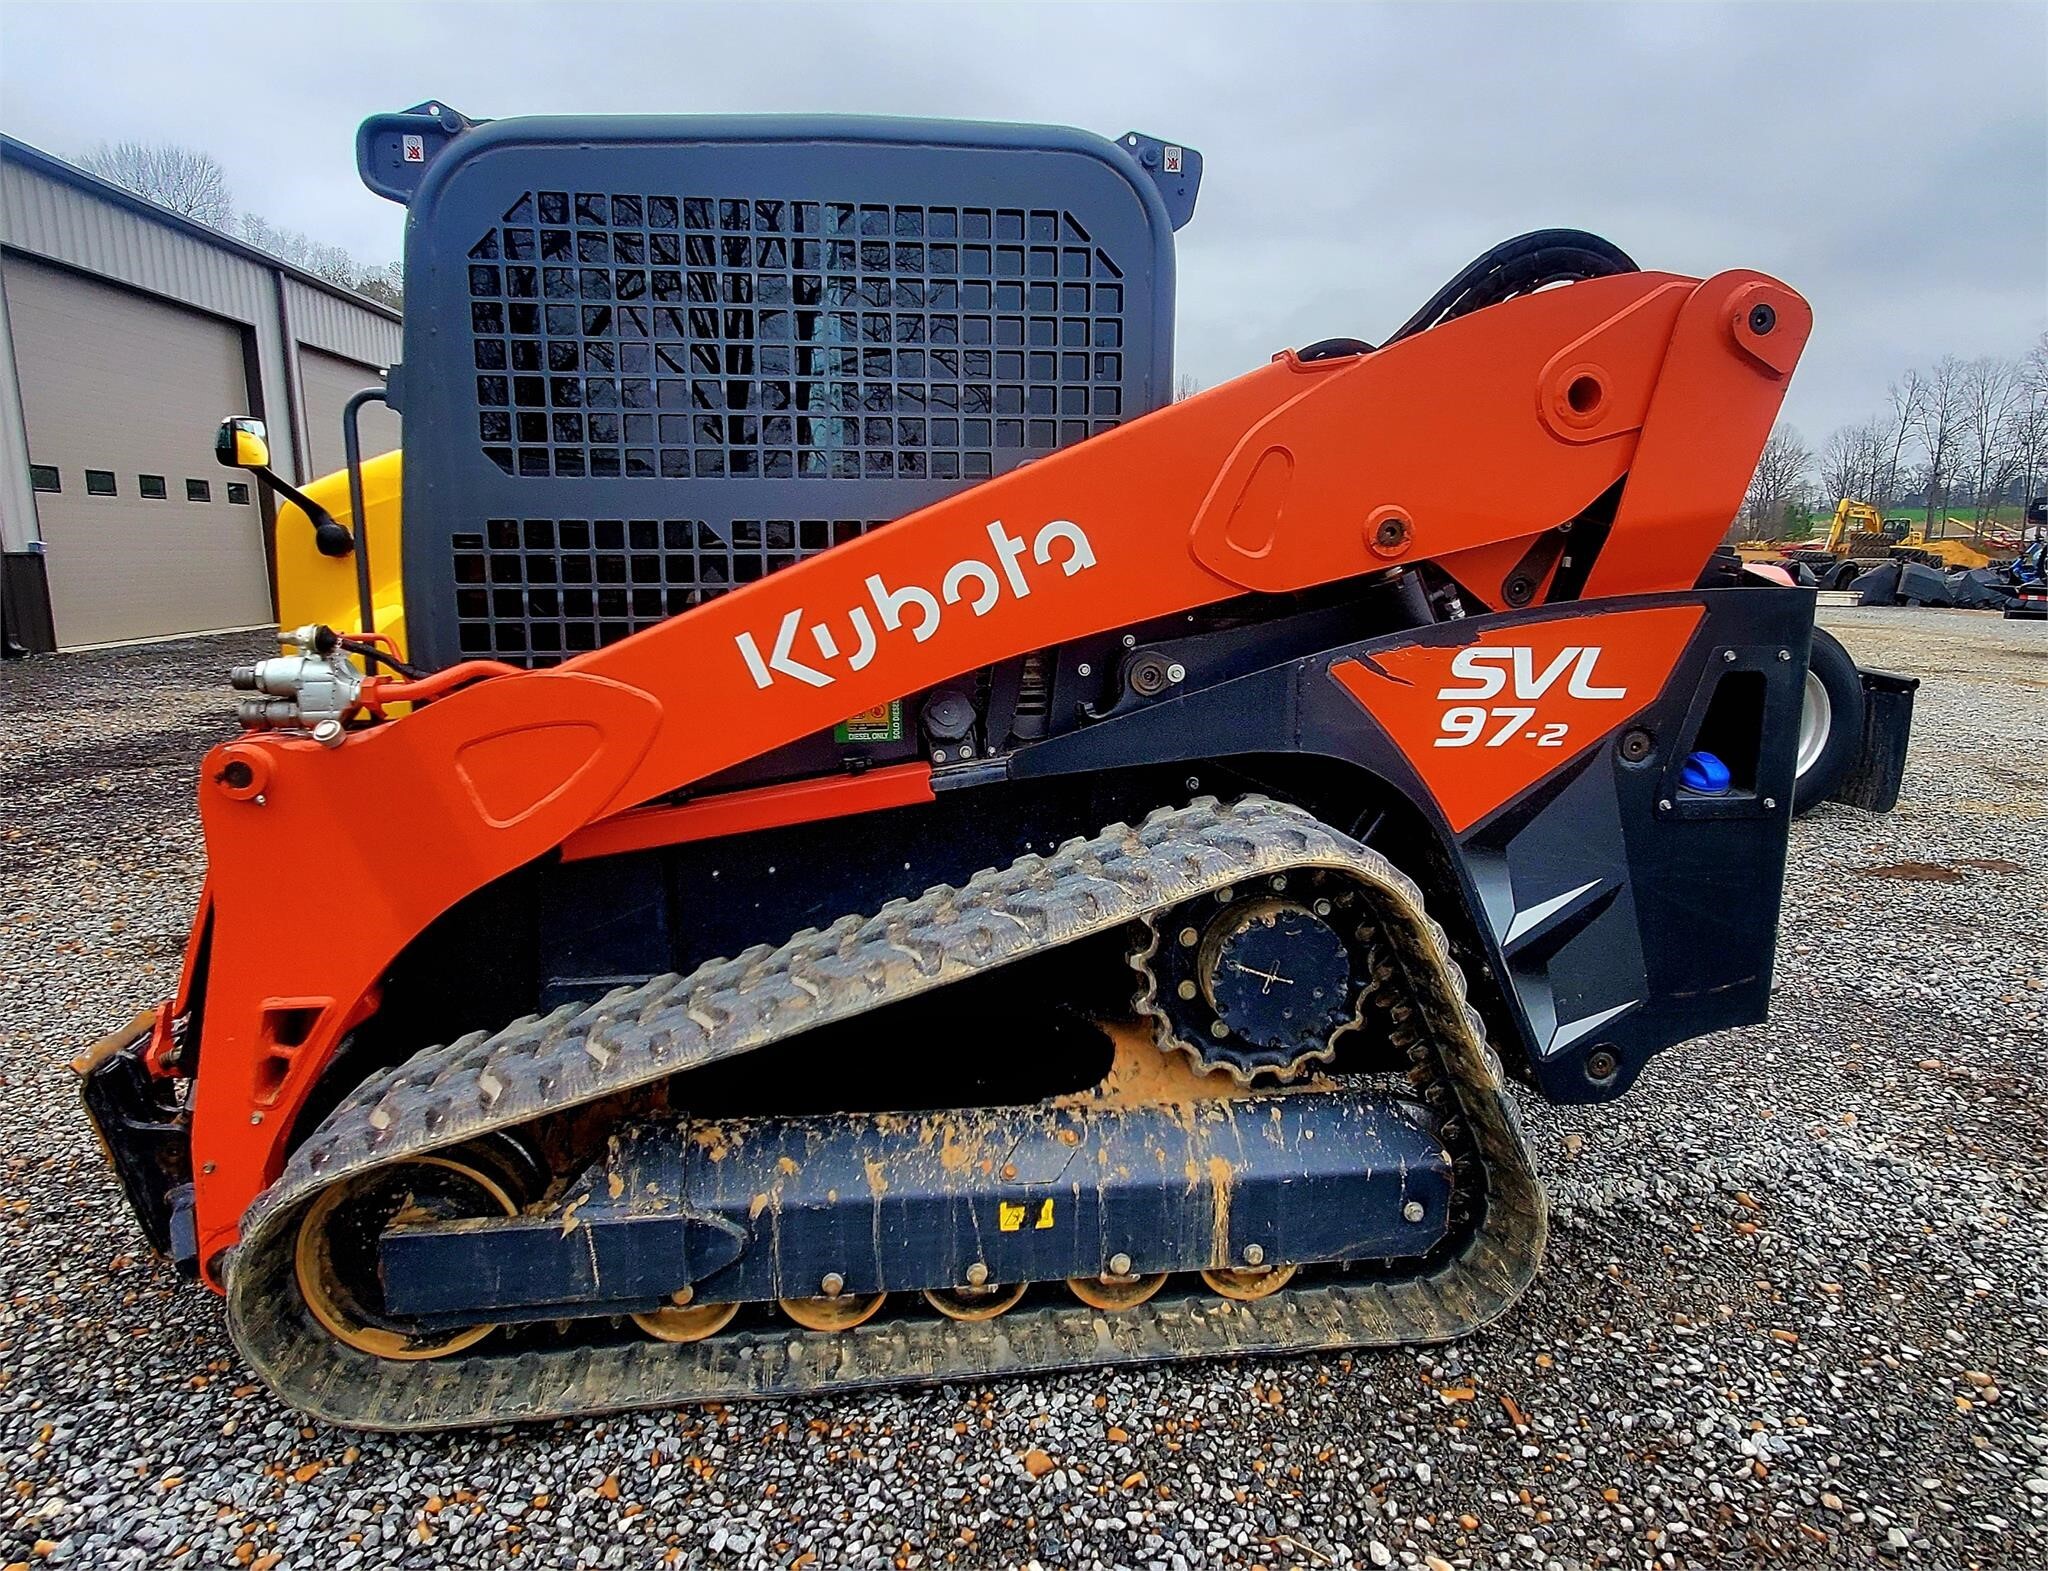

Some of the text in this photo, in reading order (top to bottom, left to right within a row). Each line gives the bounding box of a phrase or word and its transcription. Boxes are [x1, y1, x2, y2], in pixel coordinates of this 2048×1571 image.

[735, 520, 1097, 689] Kubota
[1436, 647, 1628, 700] SVL
[848, 732, 889, 740] DIESEL ONLY
[892, 699, 901, 740] SOLO DIESEL
[1433, 706, 1569, 747] 97-2
